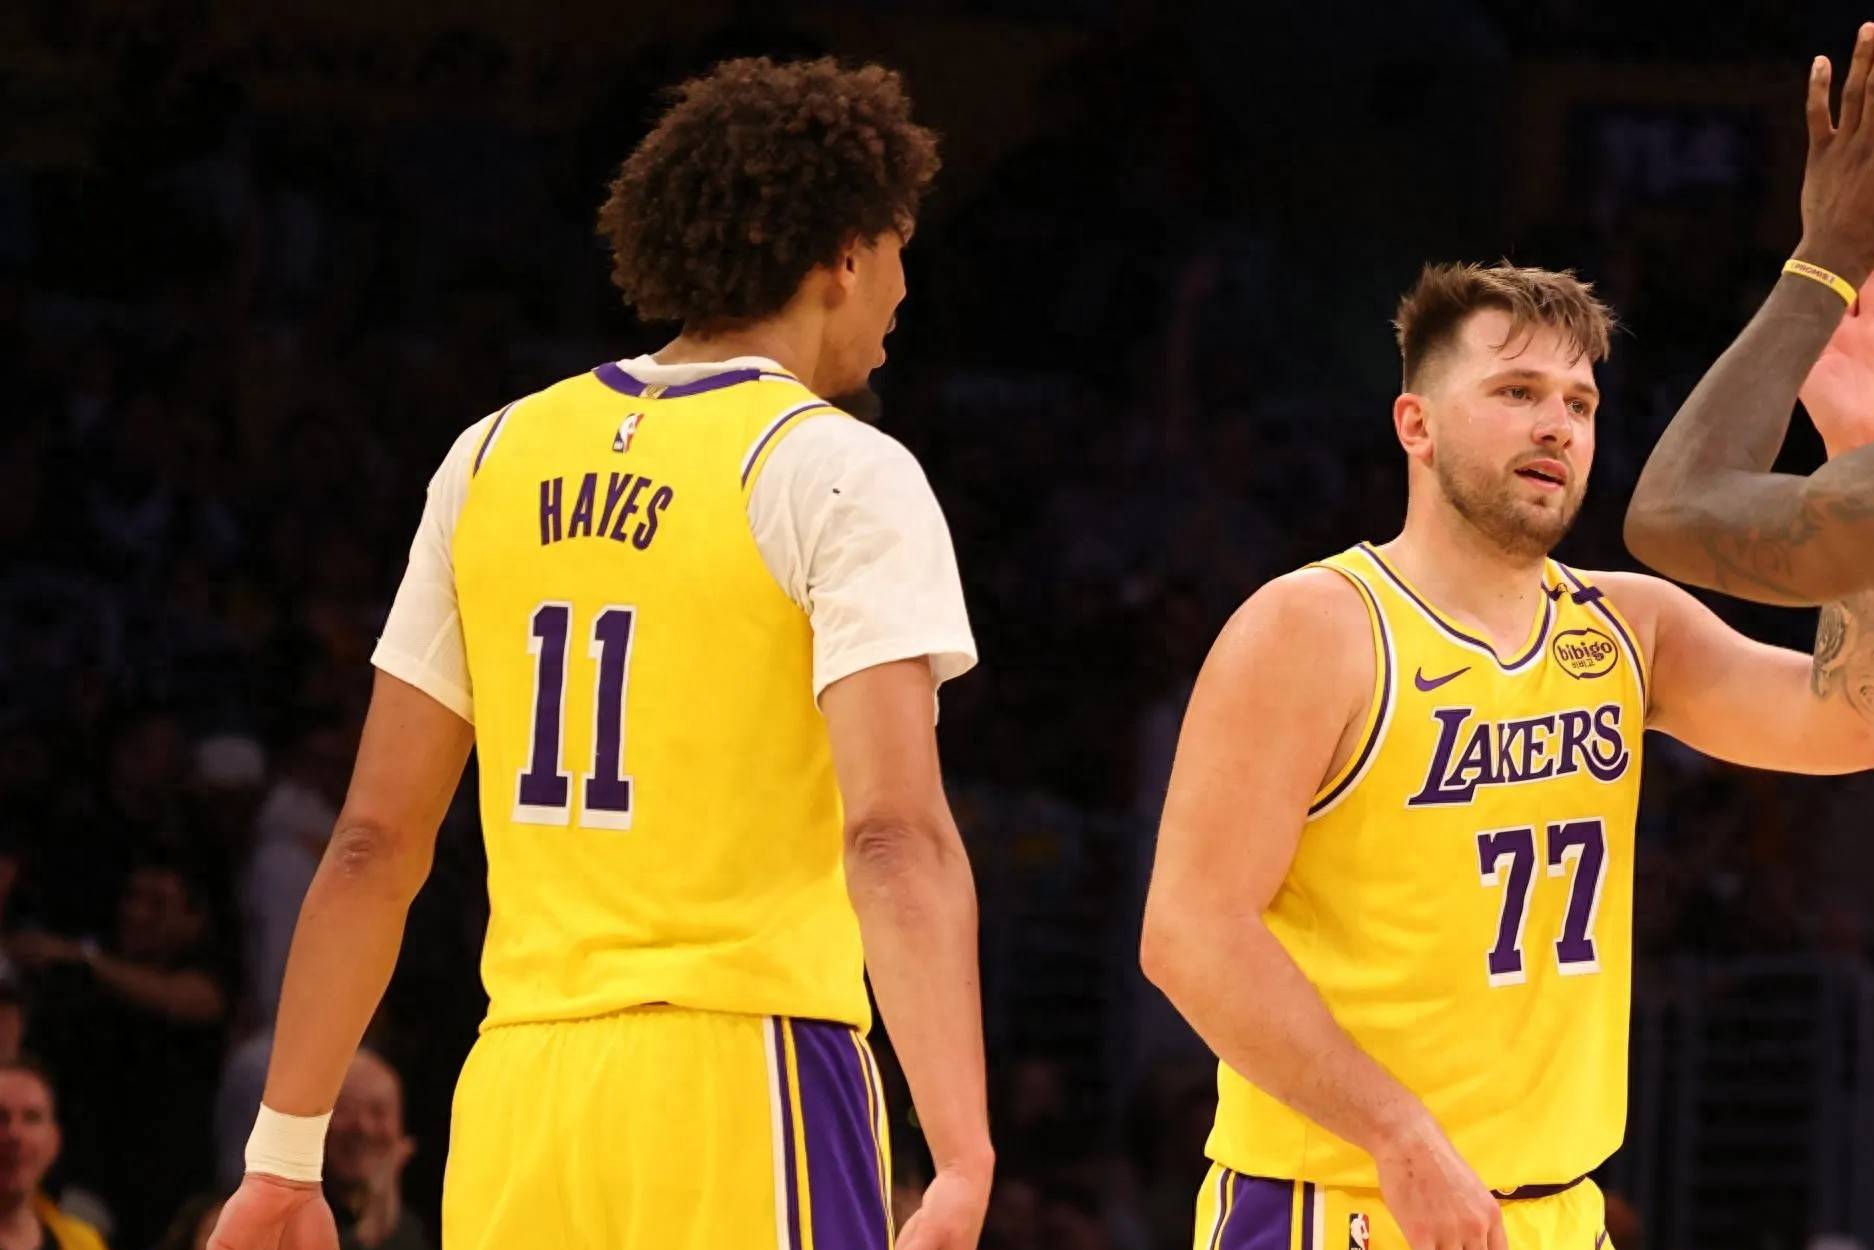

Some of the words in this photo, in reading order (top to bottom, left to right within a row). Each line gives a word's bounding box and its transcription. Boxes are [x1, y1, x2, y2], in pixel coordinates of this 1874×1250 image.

[539, 471, 674, 551] HAYES
[1557, 641, 1613, 662] bibigo
[512, 601, 637, 830] 11
[1404, 701, 1631, 810] LAKERS
[1476, 815, 1611, 988] 77
